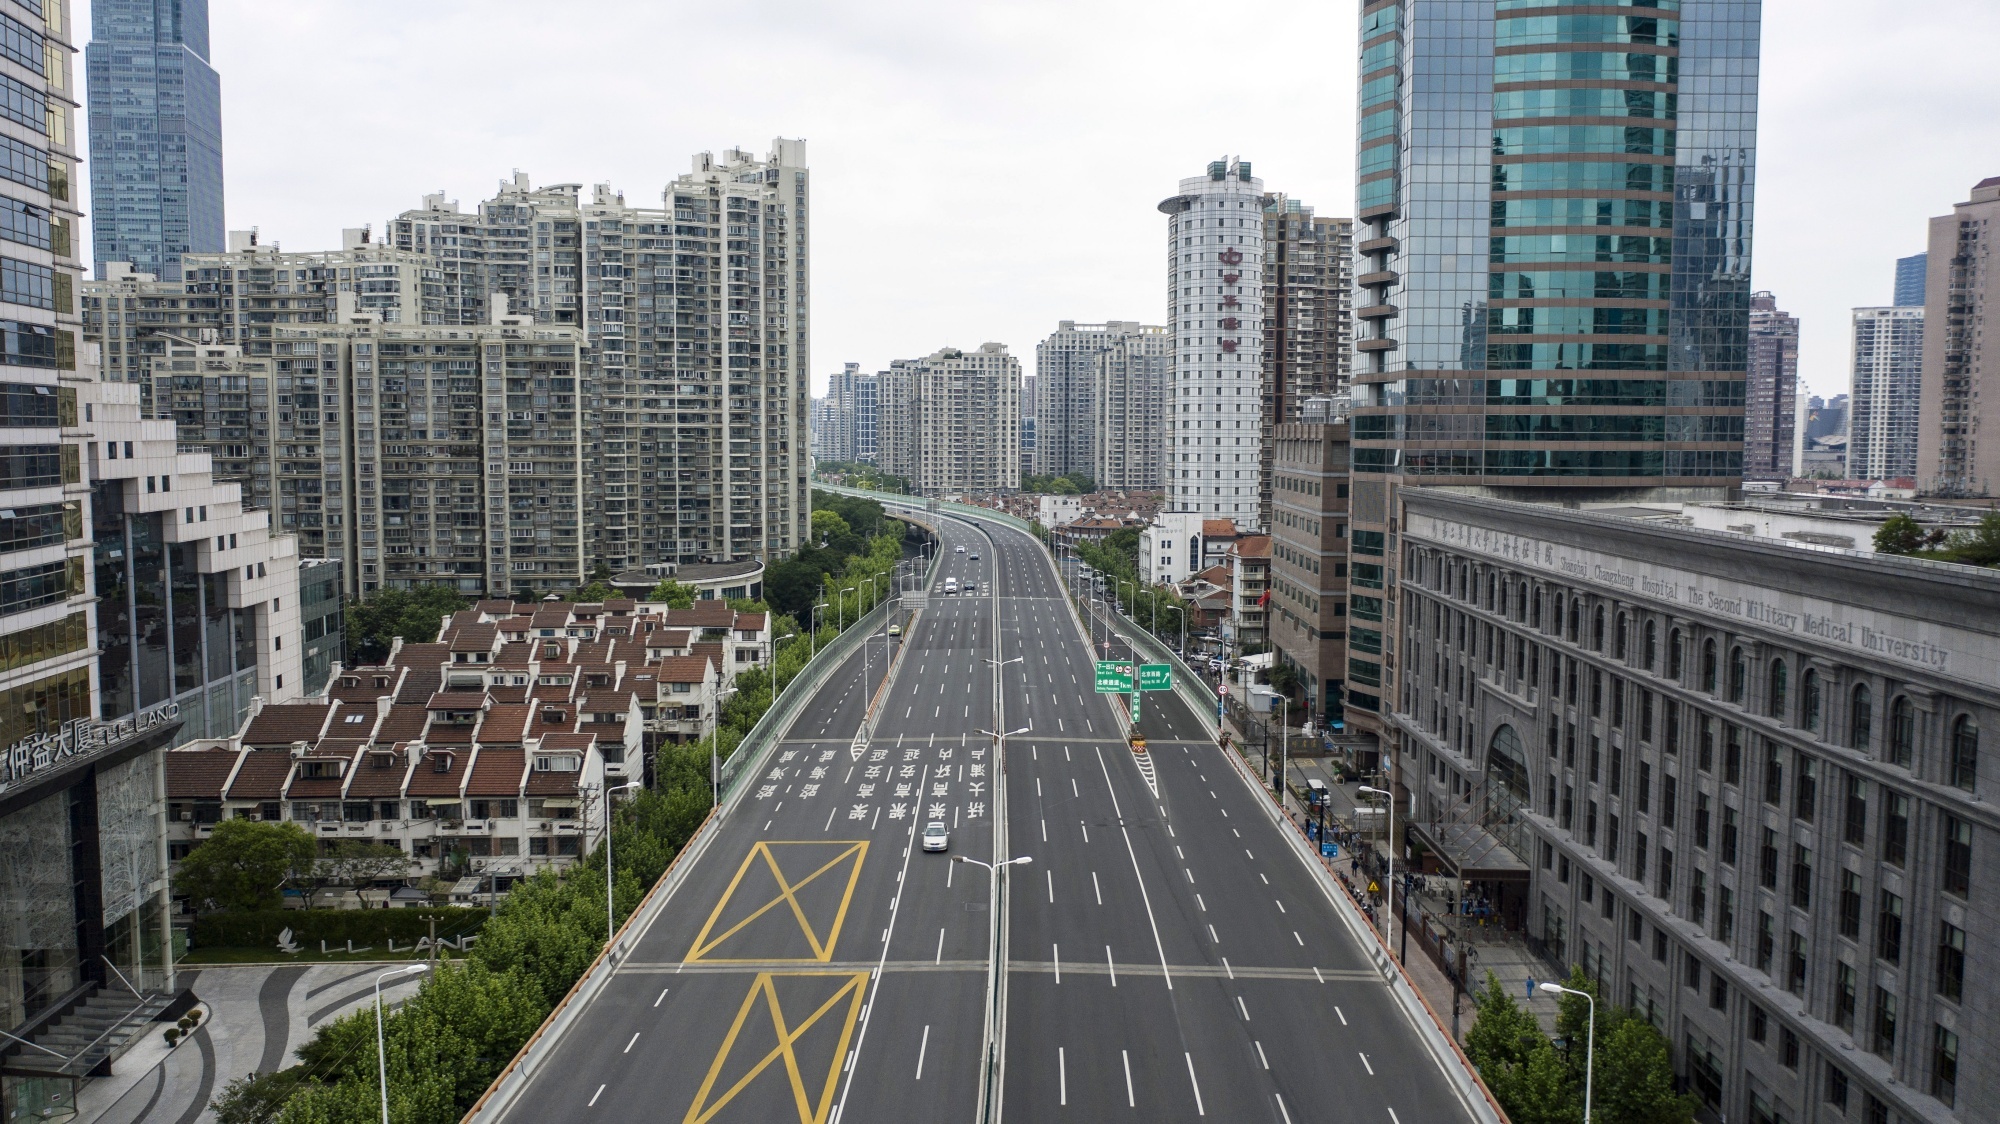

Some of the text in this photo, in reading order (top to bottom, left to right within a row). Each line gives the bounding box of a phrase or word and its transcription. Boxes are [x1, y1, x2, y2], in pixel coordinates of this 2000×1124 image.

[1560, 556, 1949, 671] Shanghai Changzheng Hospital The Second Military Medical University
[9, 717, 91, 780] 仲益大厦
[755, 750, 799, 800] 威海路
[799, 750, 837, 800] 威海路
[889, 748, 921, 821] 延安高架
[928, 748, 953, 820] 内环高架
[848, 749, 889, 821] 延安高架
